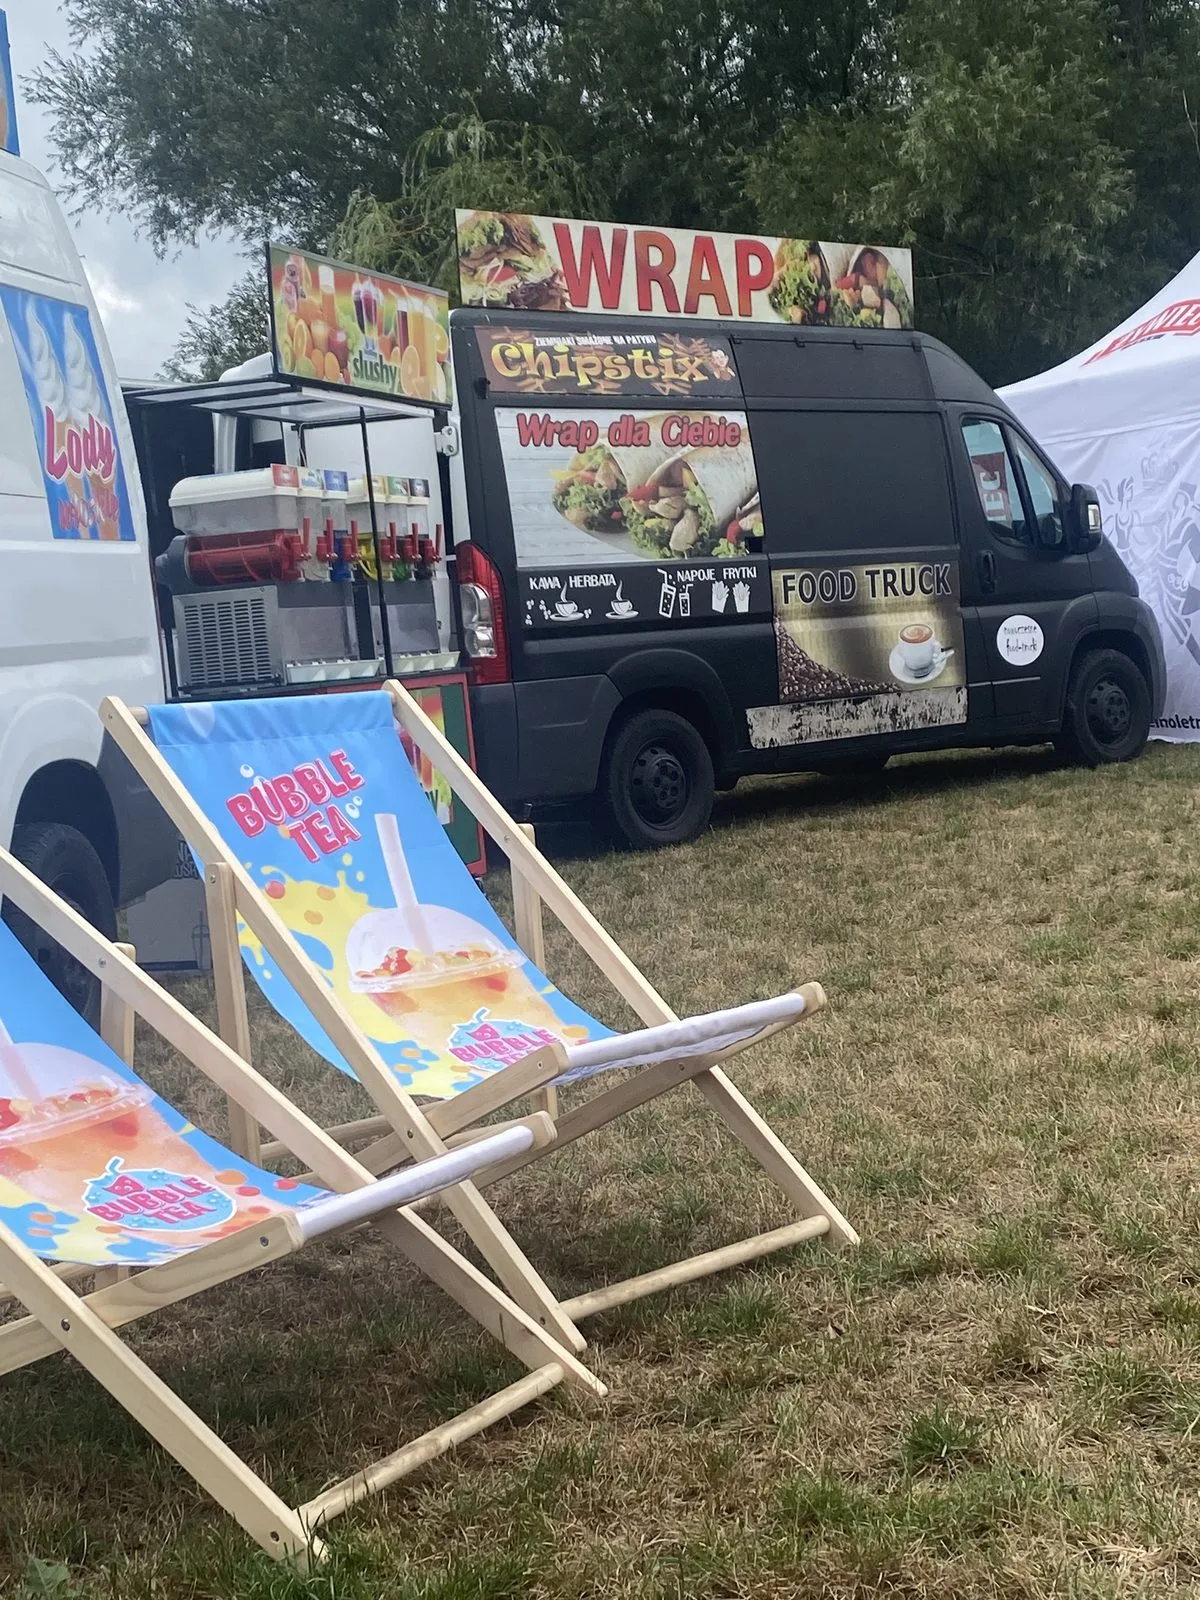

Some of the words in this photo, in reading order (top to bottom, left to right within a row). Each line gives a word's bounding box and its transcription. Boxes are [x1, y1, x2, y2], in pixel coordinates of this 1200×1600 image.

[552, 222, 775, 317] WRAP
[577, 334, 613, 345] SMAŻONE
[614, 335, 626, 345] NA
[627, 334, 656, 344] PATYKU
[353, 350, 398, 388] slushy
[491, 341, 709, 387] Chipstix
[45, 405, 115, 480] Lody
[516, 413, 599, 453] Wrap
[608, 414, 650, 447] dla
[661, 415, 741, 447] Ciebie
[529, 577, 561, 590] KAWA
[569, 574, 617, 588] HERBATA
[677, 568, 716, 582] NAPOJE
[723, 566, 757, 580] FRYTKI
[782, 569, 857, 606] FOOD
[865, 564, 952, 599] TRUCK
[226, 749, 366, 838] BUBBLE
[287, 803, 362, 863] TEA
[449, 1028, 559, 1063] BUBBLE
[87, 1176, 216, 1222] BUBBLE
[143, 1201, 217, 1224] TEA
